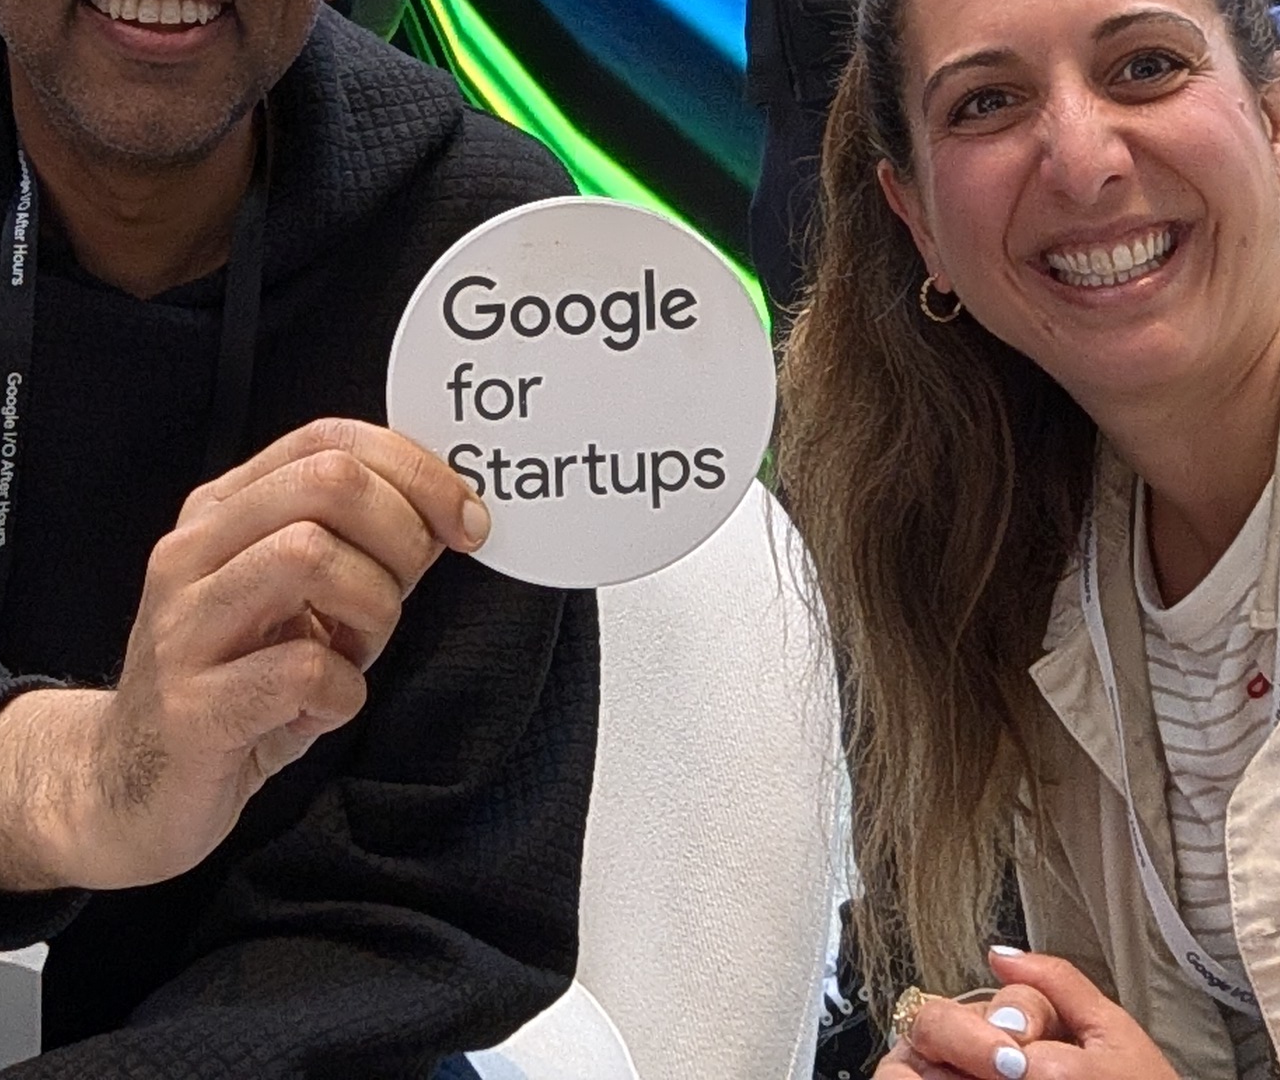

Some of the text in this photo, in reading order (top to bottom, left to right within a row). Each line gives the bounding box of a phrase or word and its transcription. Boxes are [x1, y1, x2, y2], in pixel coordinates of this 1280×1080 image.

[14, 212, 29, 241] After
[11, 244, 28, 286] Hours
[442, 269, 698, 351] Google
[1, 372, 22, 429] Google
[446, 362, 543, 422] for
[1, 431, 18, 458] I/O
[448, 443, 726, 509] Startups
[1186, 951, 1231, 991] Google
